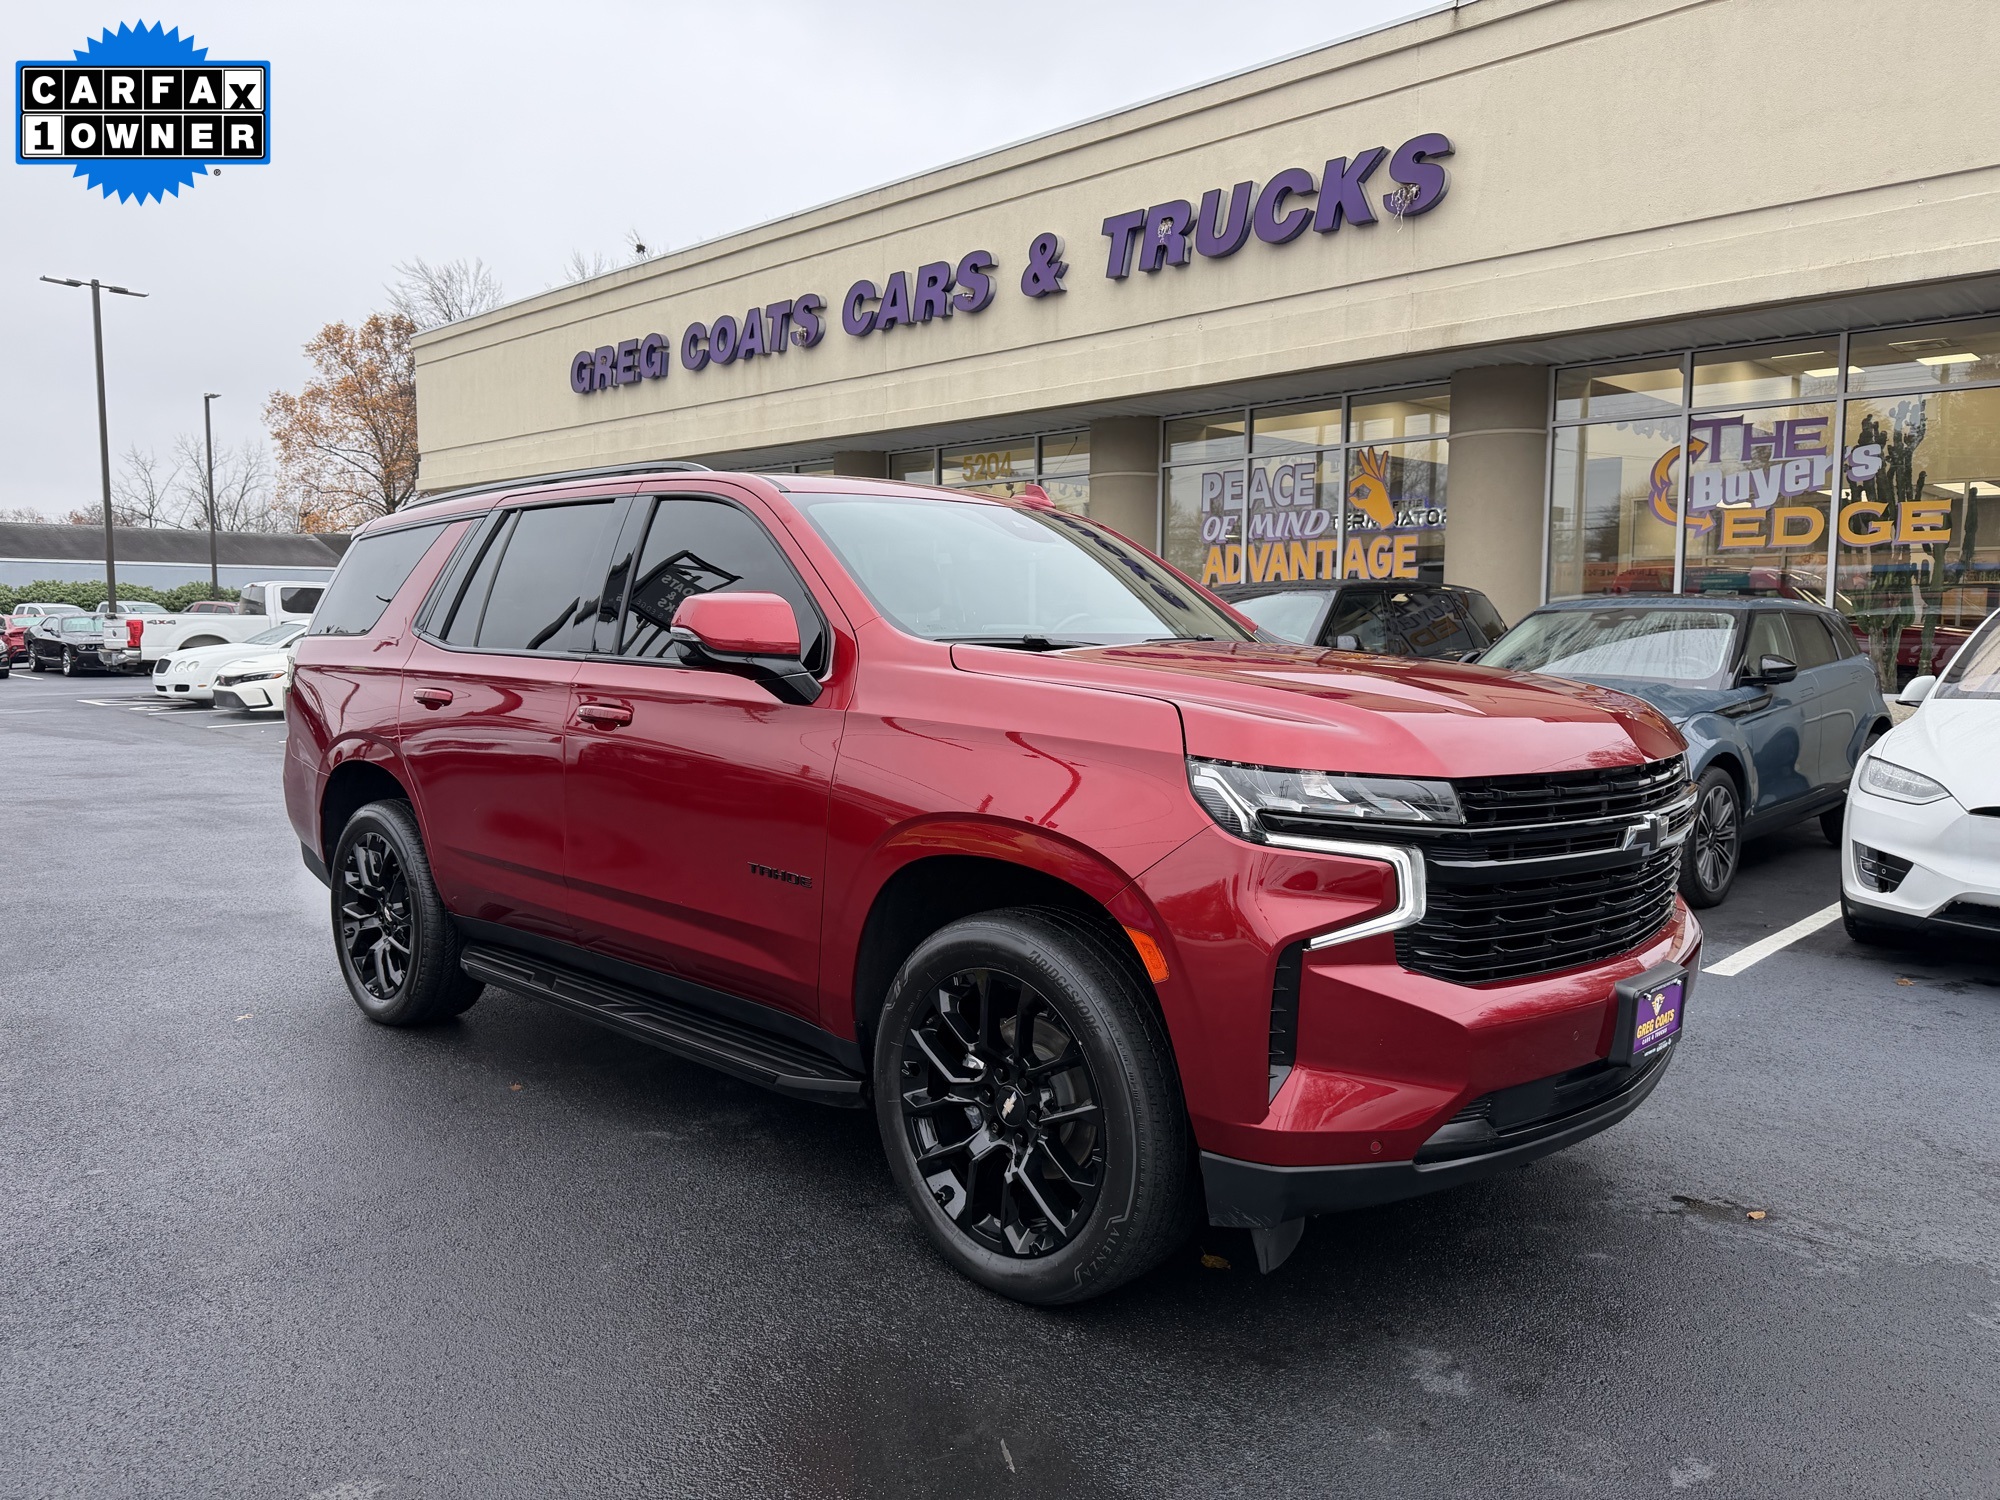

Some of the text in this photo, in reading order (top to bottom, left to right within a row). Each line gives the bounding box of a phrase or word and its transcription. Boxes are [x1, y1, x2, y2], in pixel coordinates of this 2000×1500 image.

[570, 132, 1456, 394] GREG COATS CARS & TRUCKS
[1690, 413, 1829, 464] THE
[961, 451, 1013, 483] 5204
[1201, 462, 1317, 514] PEACE
[1202, 509, 1331, 544] OF MIND
[1718, 498, 1953, 550] EDGE
[1201, 534, 1420, 586] ADVANTAGE
[747, 861, 813, 889] TAHOE
[1026, 949, 1103, 1036] BRIDGESTONE
[1636, 1008, 1676, 1039] GREG COATS
[1083, 1227, 1121, 1278] ALENZA
